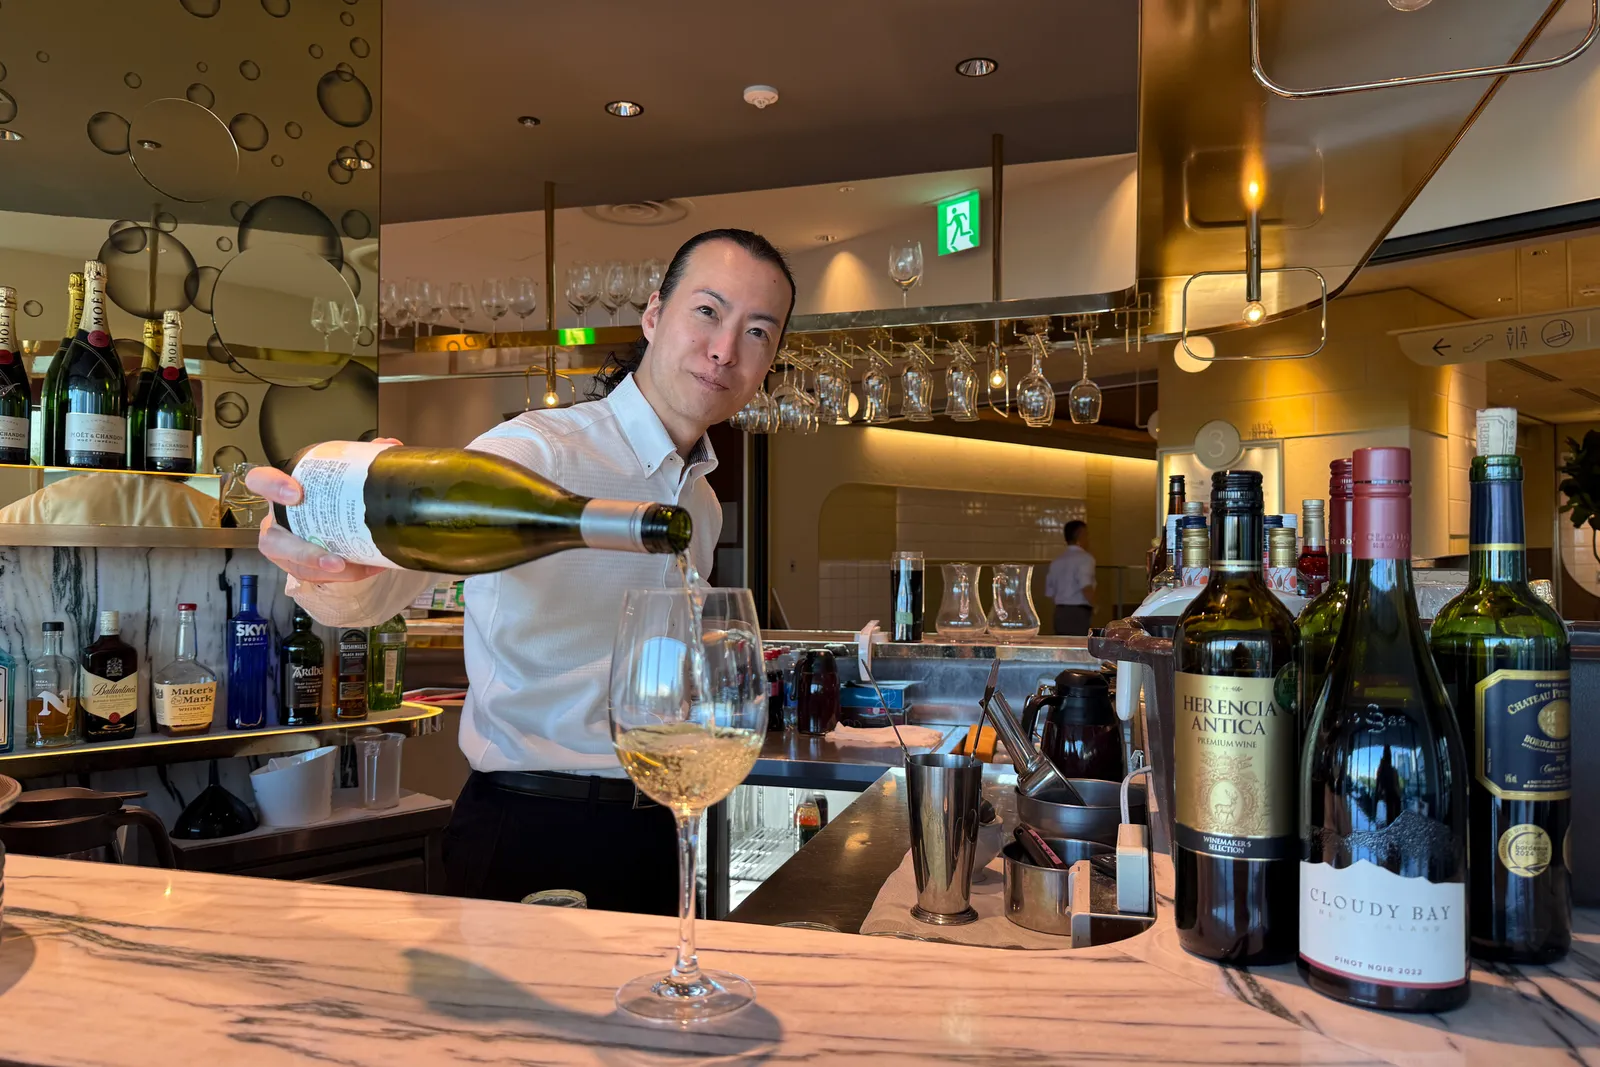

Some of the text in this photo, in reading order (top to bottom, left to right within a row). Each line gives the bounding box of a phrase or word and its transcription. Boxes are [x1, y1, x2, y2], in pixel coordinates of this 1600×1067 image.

[1208, 430, 1225, 458] 3
[236, 624, 268, 637] SKYY
[92, 682, 137, 696] Ballantine's
[171, 687, 214, 696] Maker's
[183, 695, 212, 704] Mark
[1183, 695, 1278, 717] HERENCIA
[1507, 690, 1551, 715] CHATEAU
[1191, 715, 1267, 736] ANTICA
[1197, 737, 1257, 749] PREMIUM WINE
[1208, 843, 1244, 854] SELECTION
[1310, 887, 1451, 921] CLOUDY BAY
[1334, 955, 1364, 968] PINOT
[1368, 961, 1394, 973] NOIR
